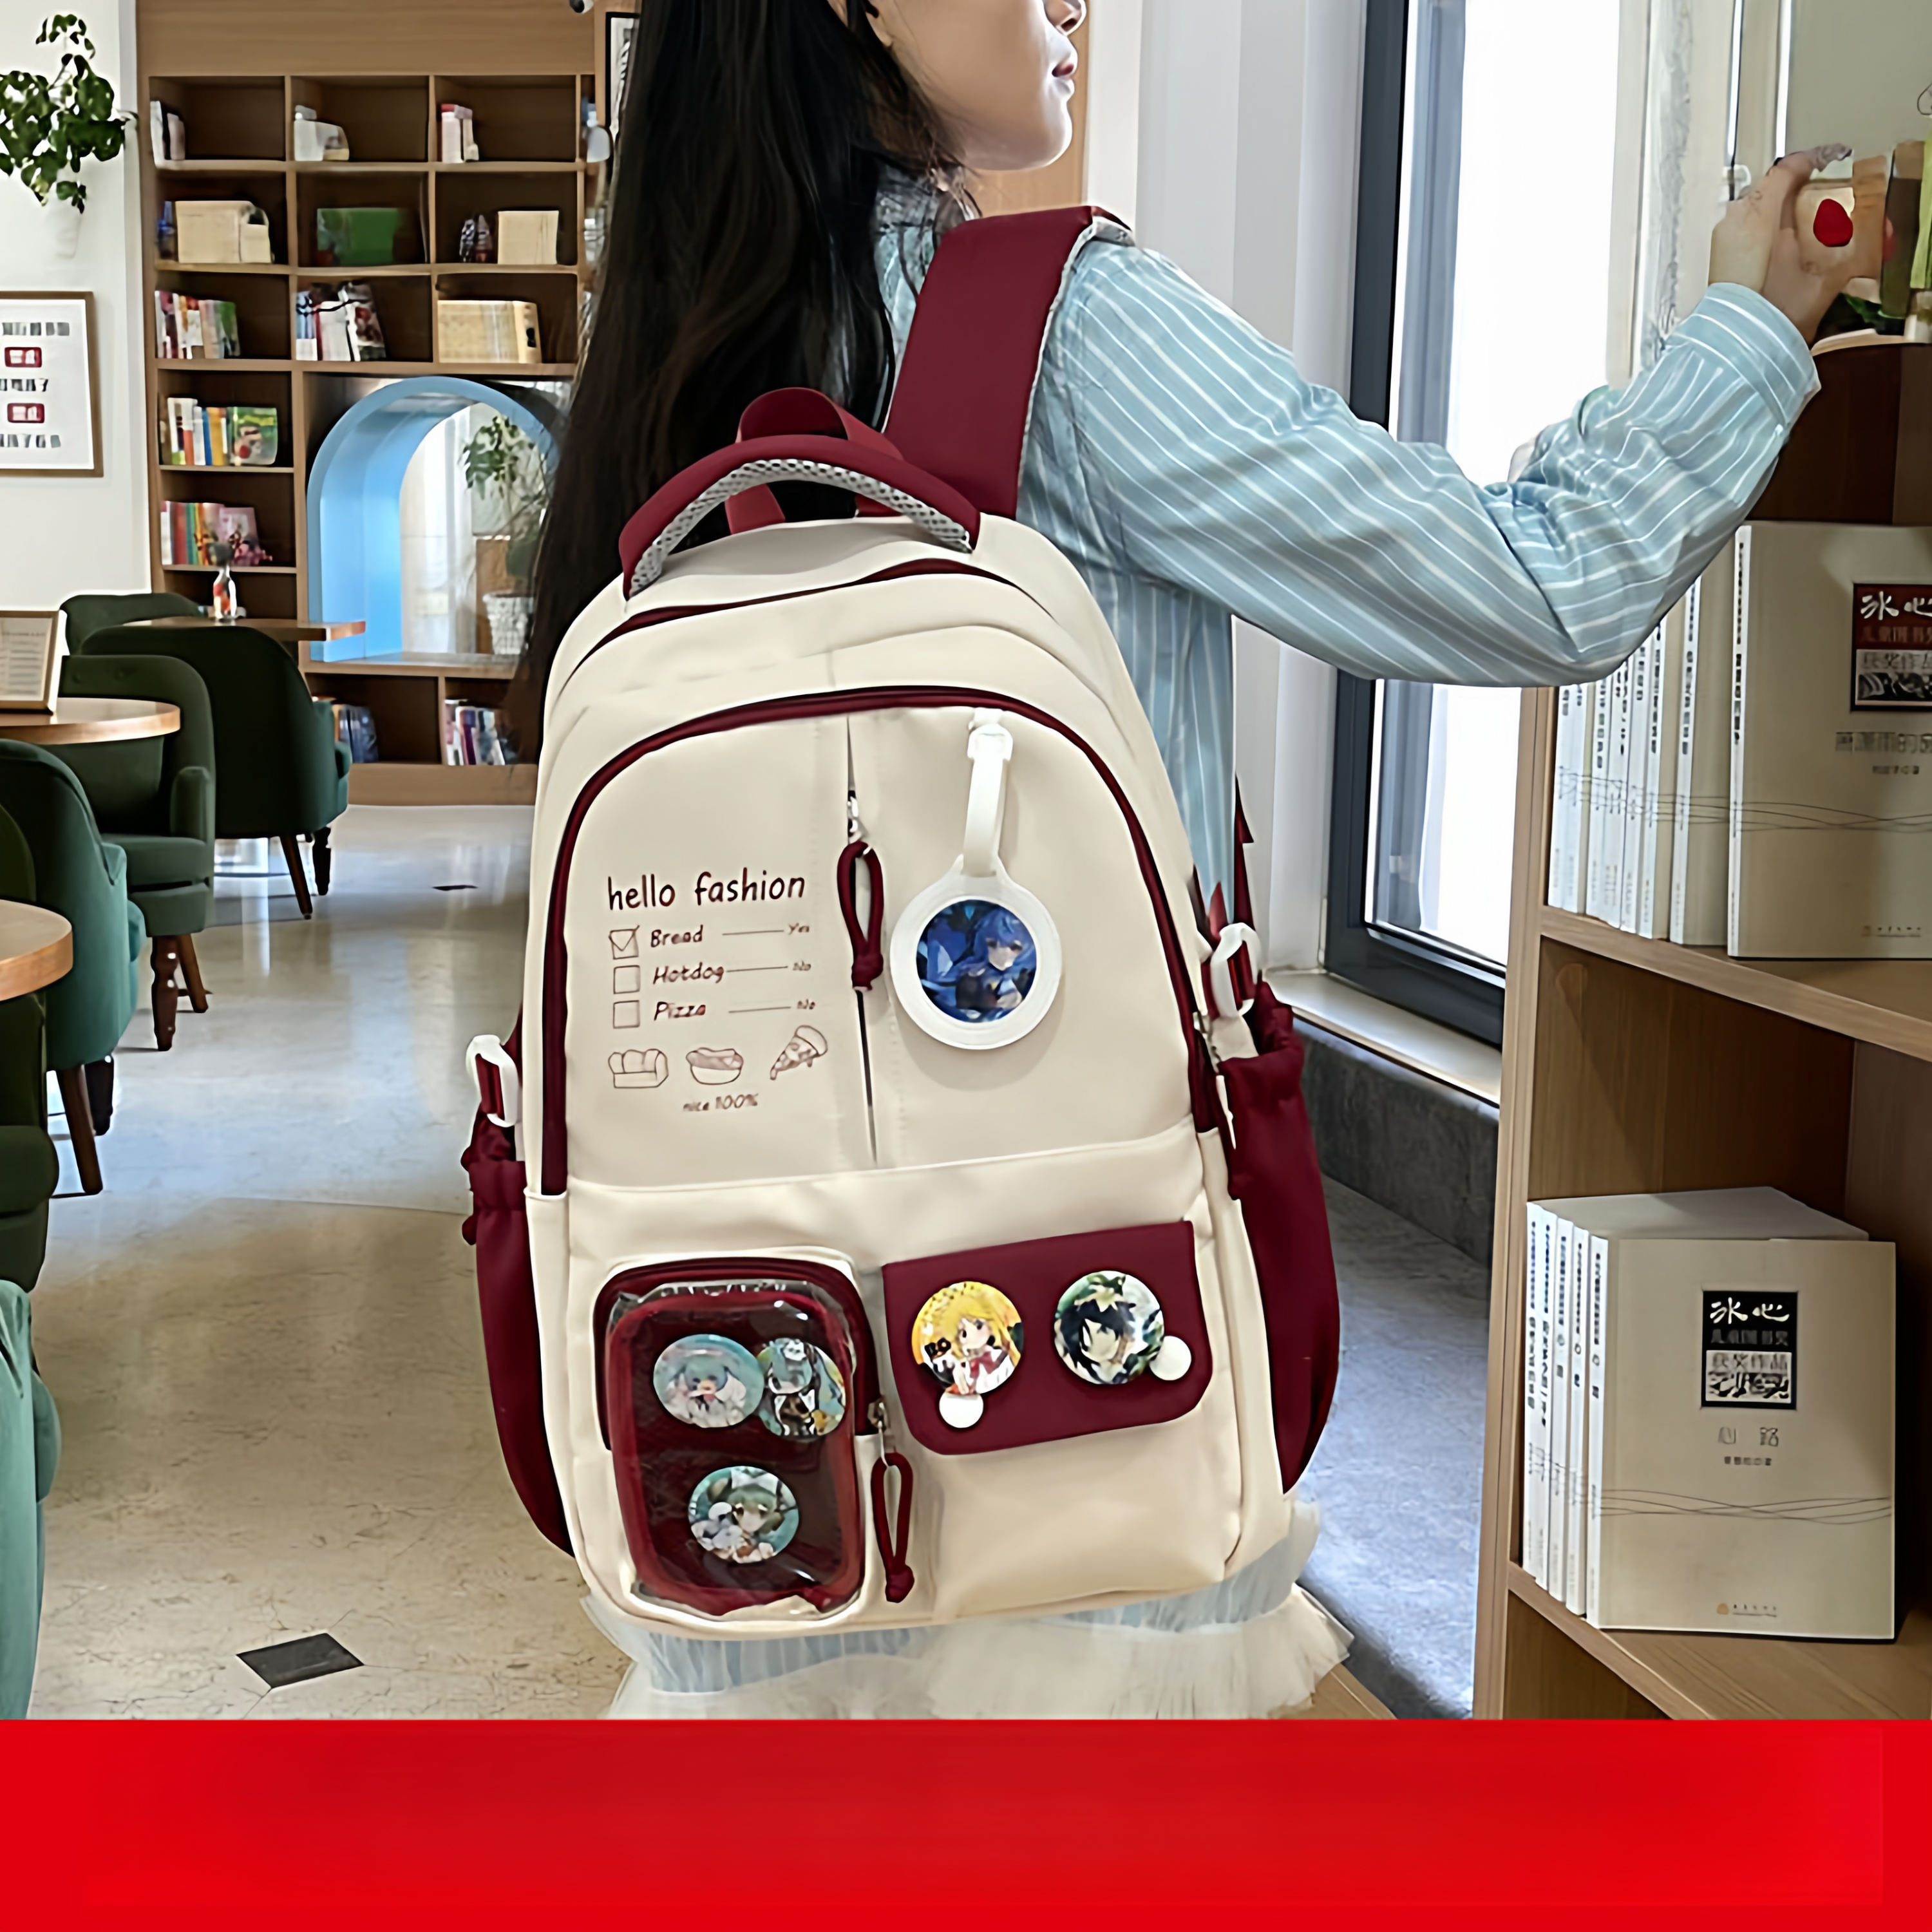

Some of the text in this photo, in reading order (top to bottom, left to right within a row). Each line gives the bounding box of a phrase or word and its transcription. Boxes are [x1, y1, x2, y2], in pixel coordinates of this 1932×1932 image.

[607, 866, 806, 911] hello fashion
[650, 924, 704, 948] Bread
[652, 961, 724, 985] Hotdog
[653, 1001, 706, 1021] Pizza
[1710, 1296, 1790, 1325] 冰心
